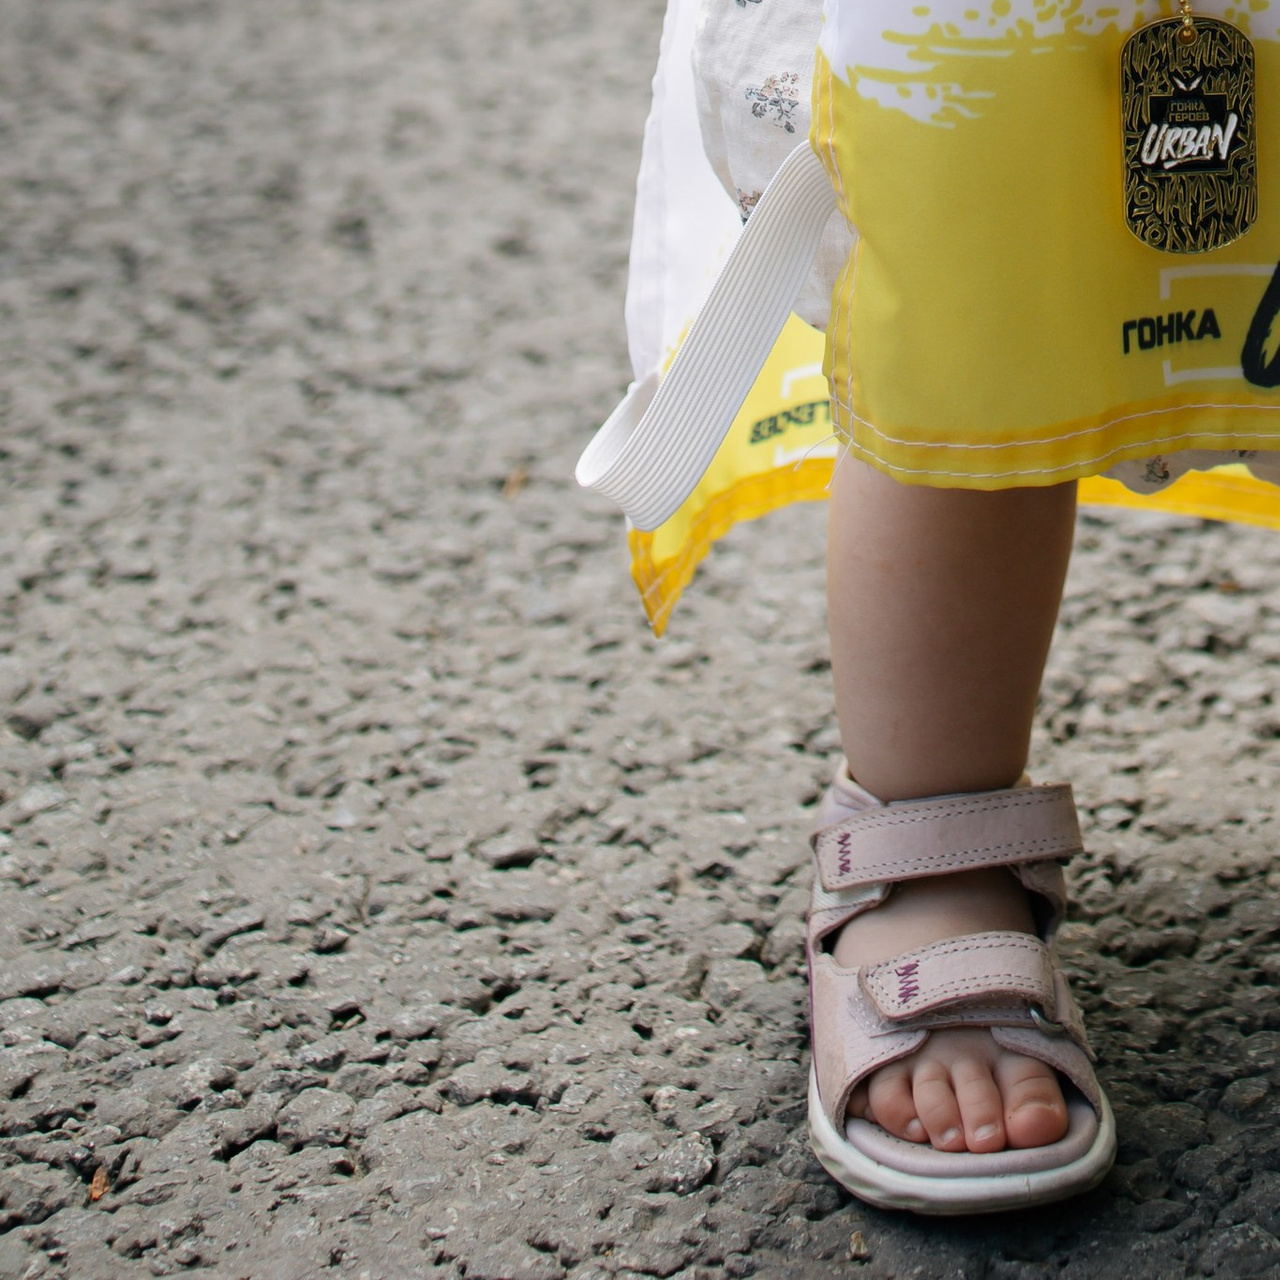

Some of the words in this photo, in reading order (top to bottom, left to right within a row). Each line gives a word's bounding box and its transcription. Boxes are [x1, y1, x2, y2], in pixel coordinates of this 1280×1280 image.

[1168, 112, 1210, 122] ГЕРОЕВ
[1170, 102, 1206, 111] ГОНКА
[1141, 112, 1238, 170] URBAN
[1122, 307, 1222, 355] ГОНКА
